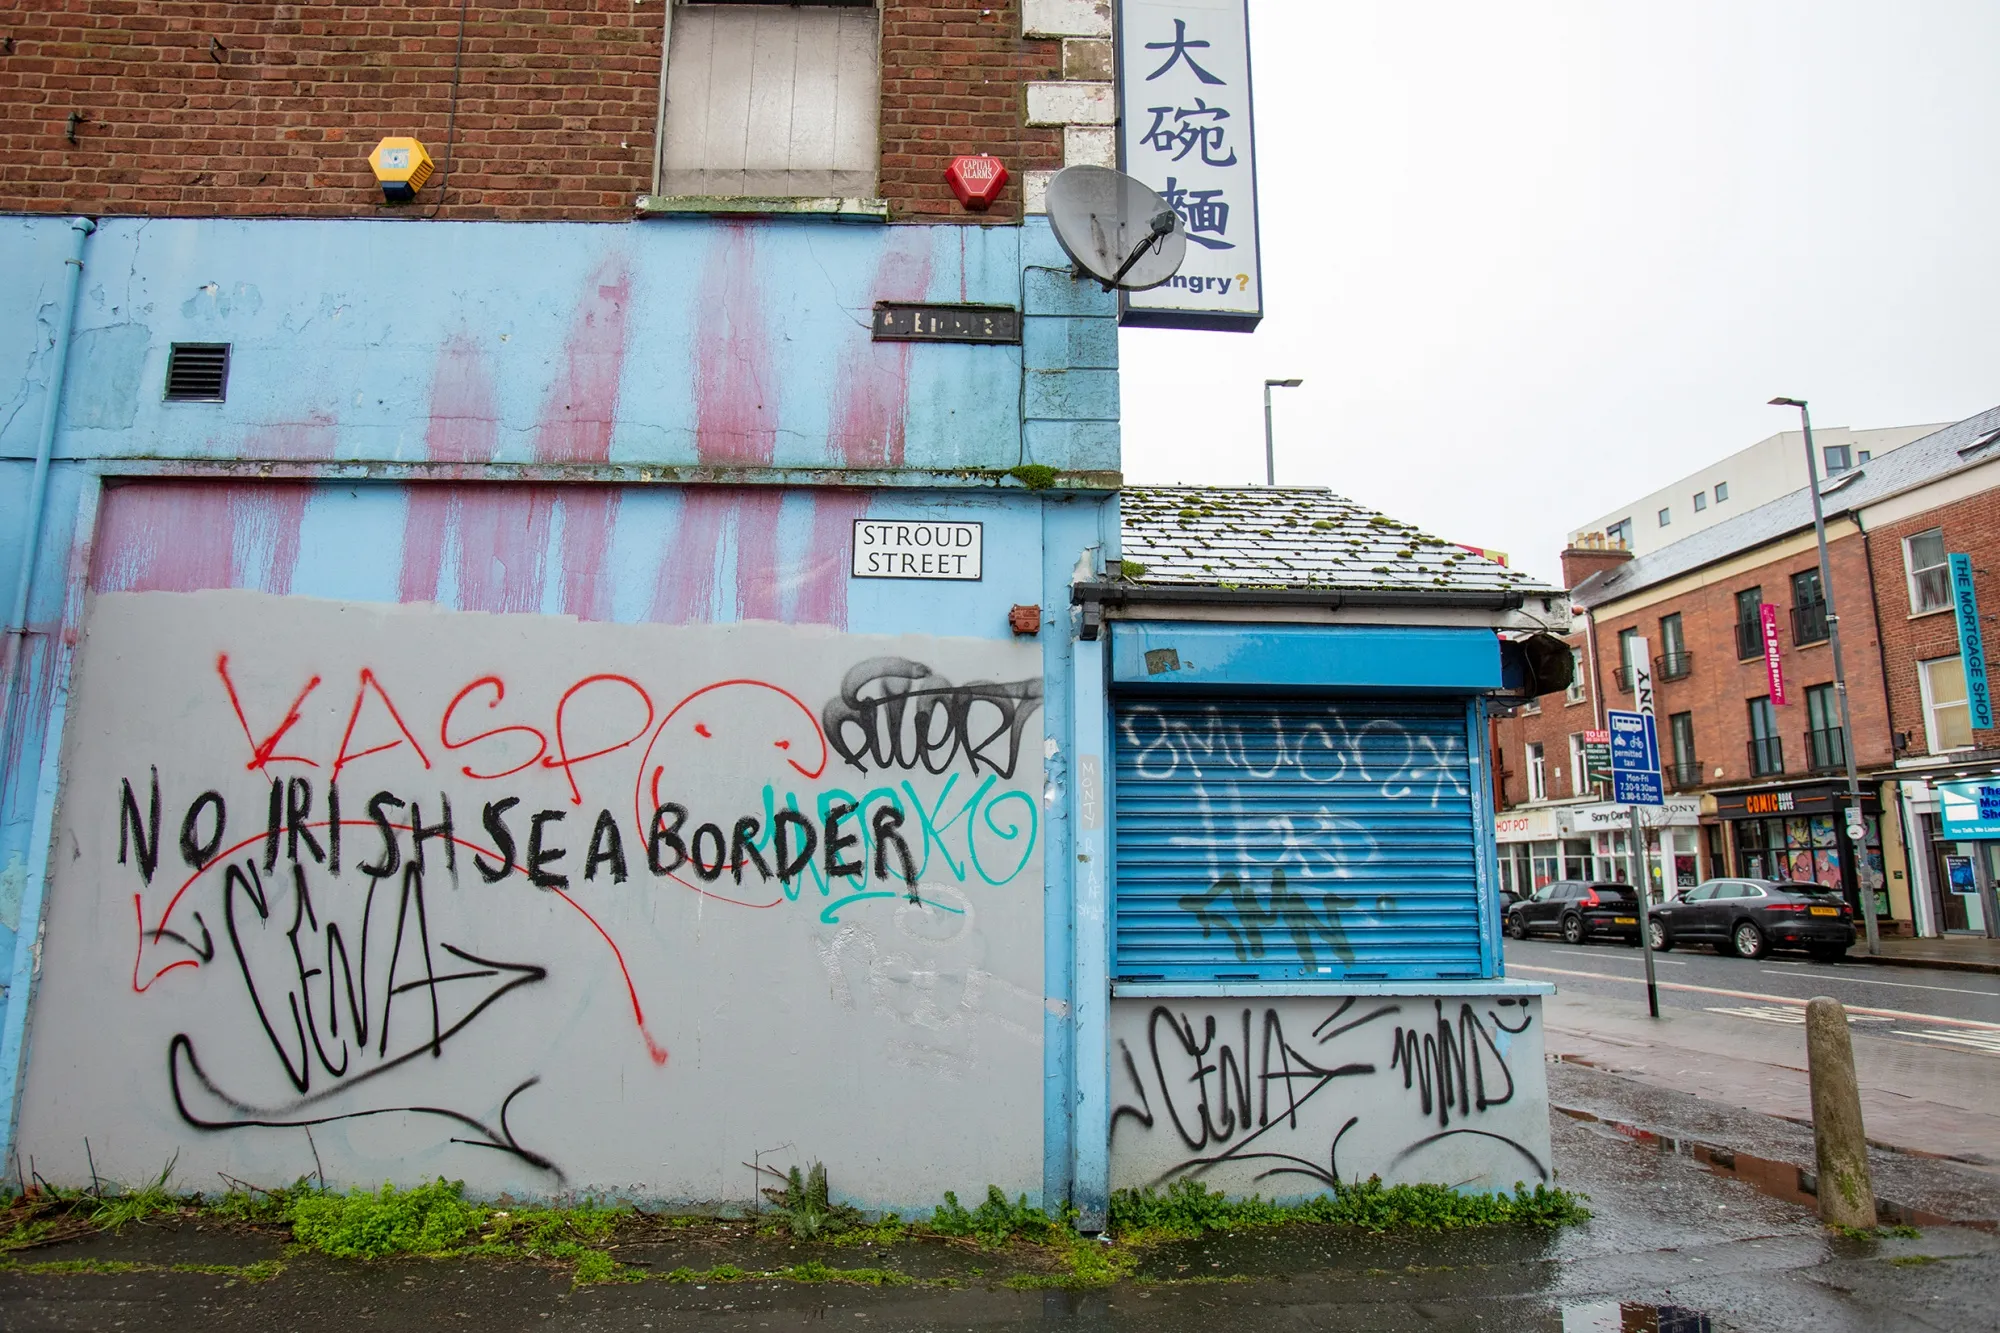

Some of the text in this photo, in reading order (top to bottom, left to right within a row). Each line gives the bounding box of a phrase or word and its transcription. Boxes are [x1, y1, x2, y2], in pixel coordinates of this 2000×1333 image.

[963, 160, 992, 170] CAPITAL
[963, 169, 993, 179] ALARMS
[863, 525, 972, 547] STROUD
[868, 552, 967, 574] STREET
[1765, 623, 1776, 637] La
[1955, 557, 1989, 726] THE MORTGAGE SHOP
[1767, 639, 1780, 668] Bella
[1614, 750, 1642, 758] permitted
[1623, 759, 1635, 767] taxi
[1626, 774, 1649, 782] Mon-Fri
[1778, 792, 1793, 801] BOOK
[1747, 793, 1778, 813] COMIC
[1779, 801, 1794, 811] GUYS
[1591, 813, 1609, 823] Sony
[1496, 818, 1529, 832] HOT POT
[118, 763, 227, 888] NO
[264, 776, 459, 890] IRISH
[474, 796, 627, 890] SEA
[647, 802, 922, 907] BORDER
[1678, 878, 1695, 886] SALE
